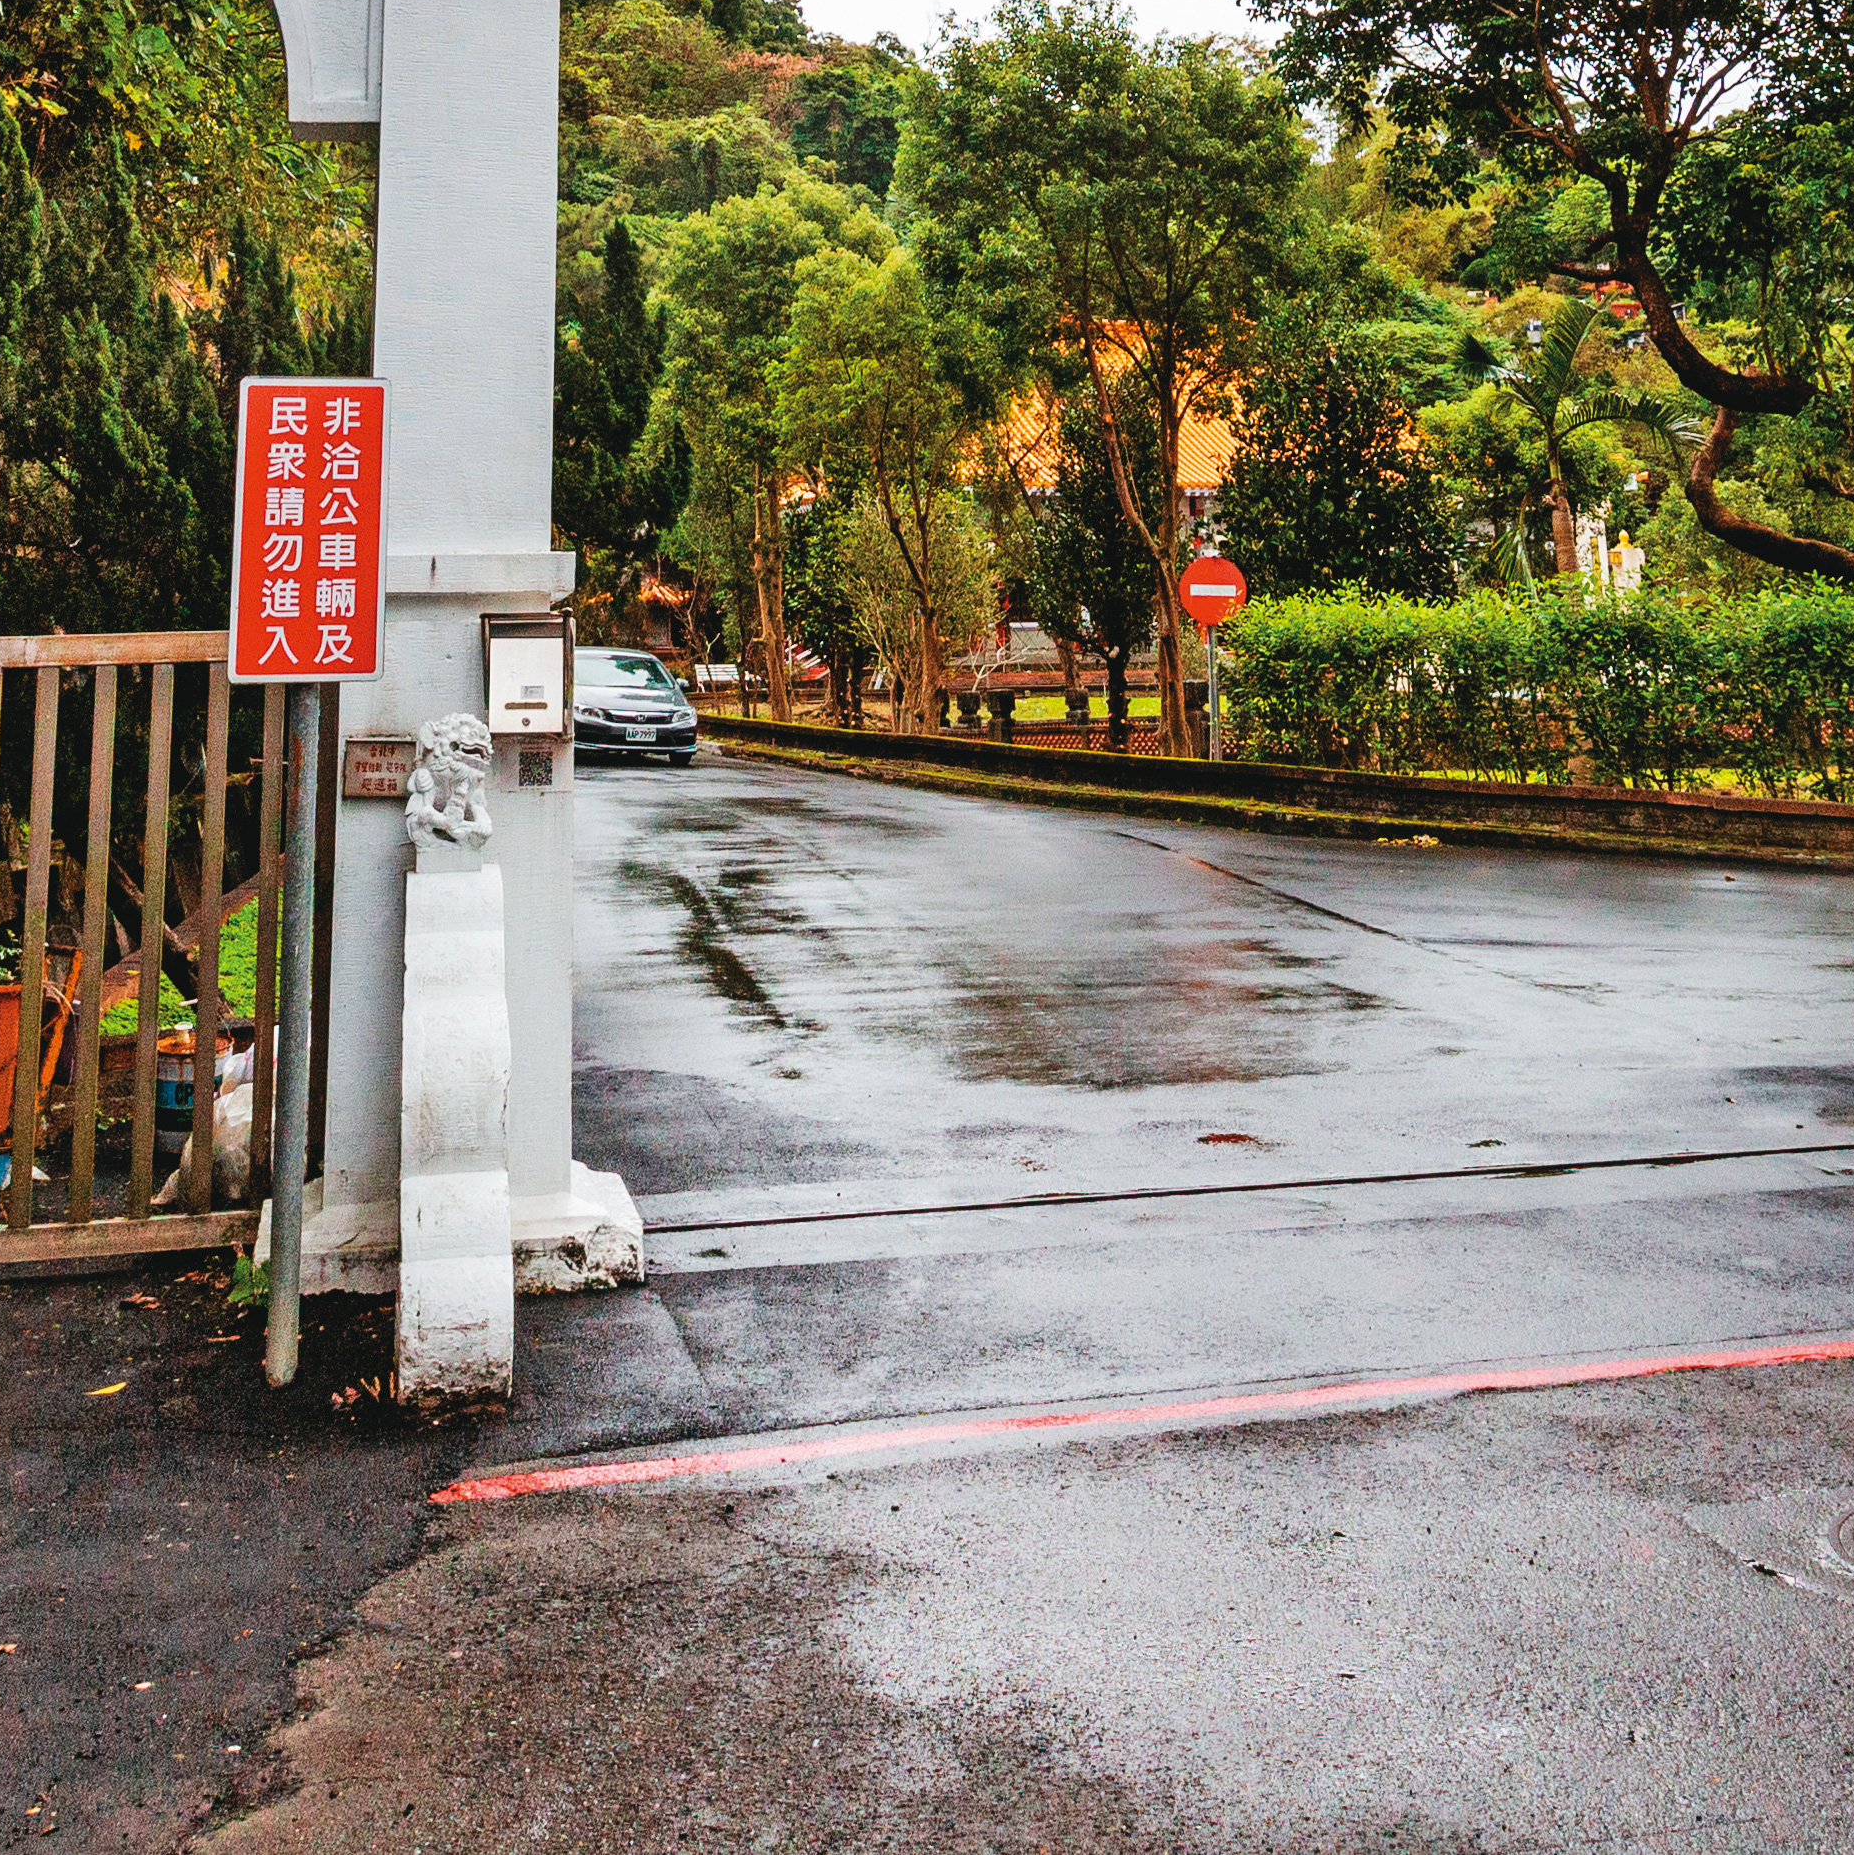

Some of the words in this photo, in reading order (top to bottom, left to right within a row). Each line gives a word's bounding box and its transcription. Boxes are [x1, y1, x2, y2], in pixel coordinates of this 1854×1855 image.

[313, 396, 362, 665] 非洽公車輛及
